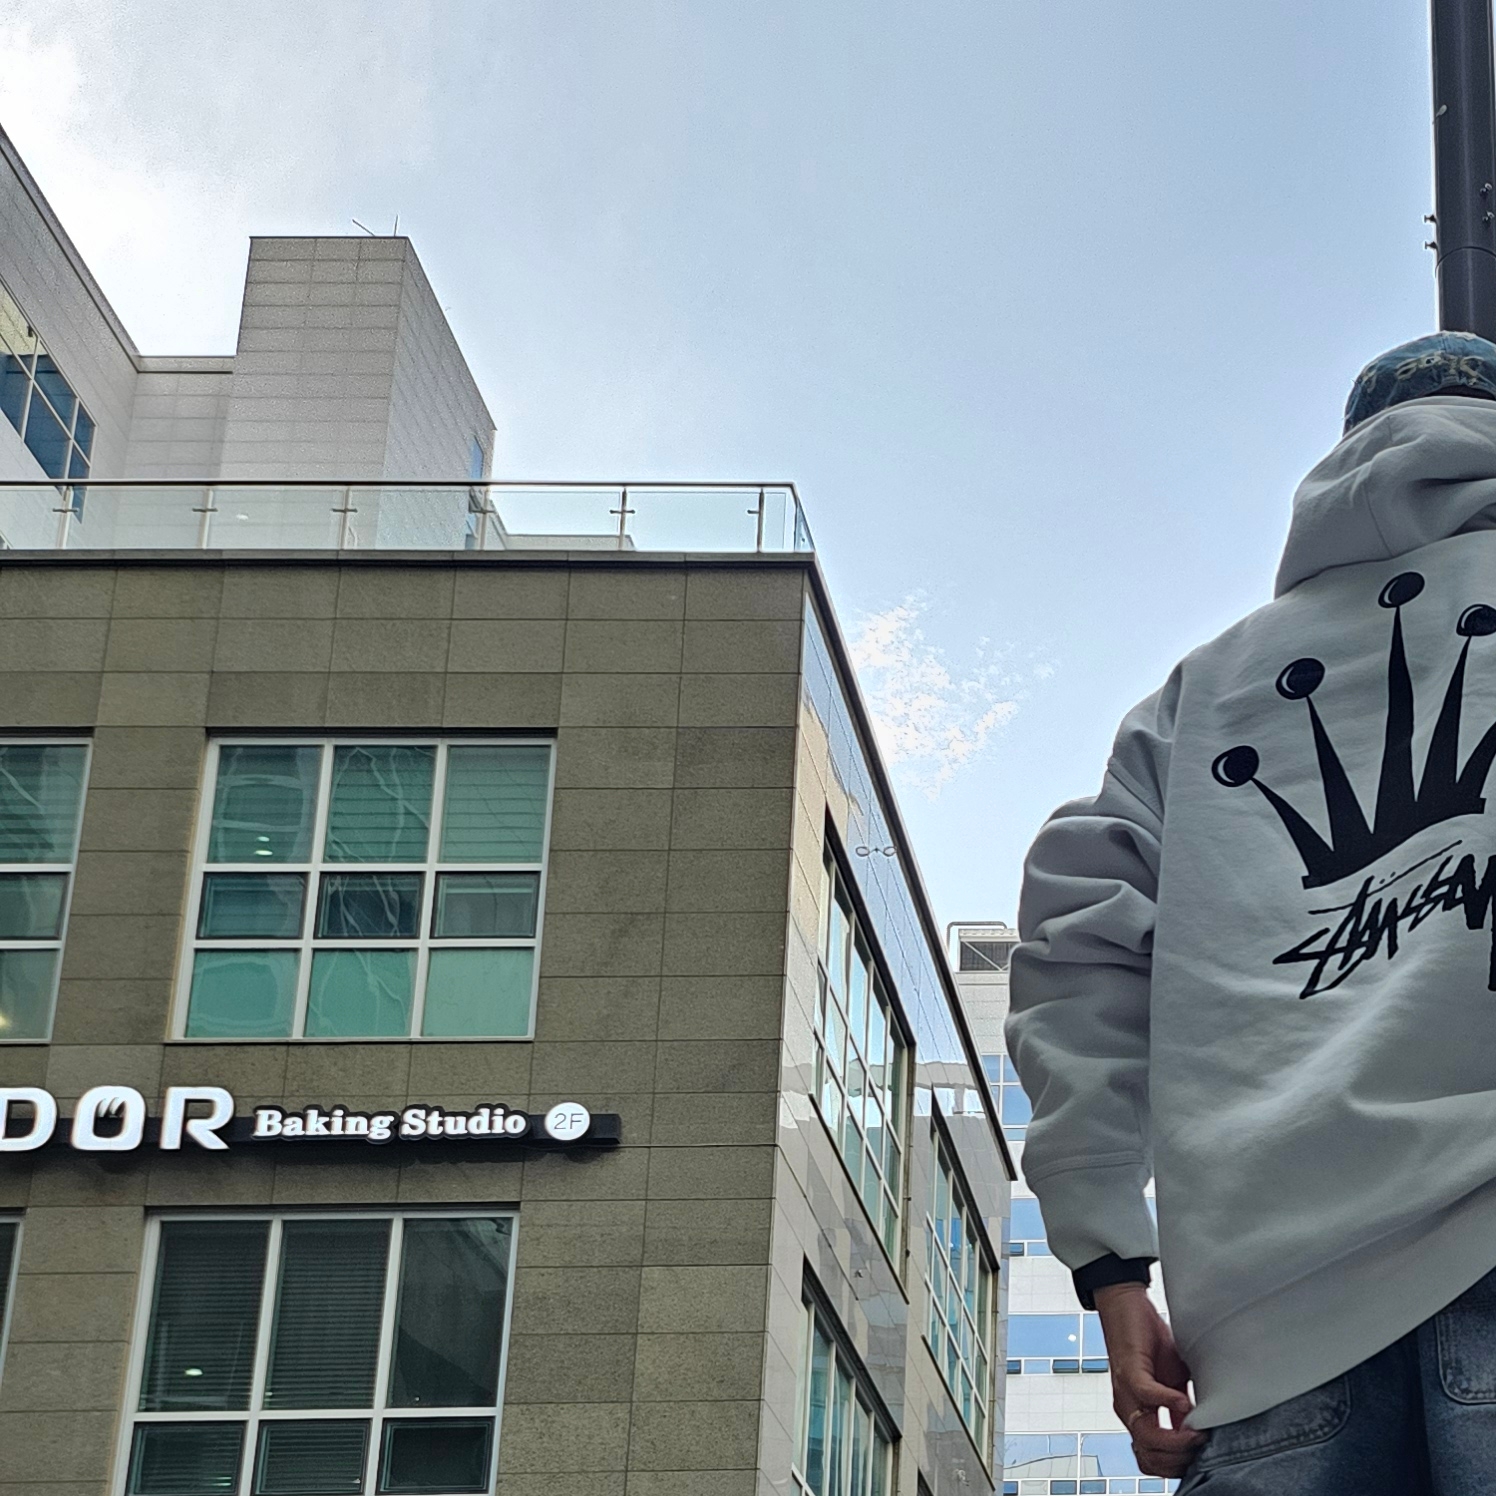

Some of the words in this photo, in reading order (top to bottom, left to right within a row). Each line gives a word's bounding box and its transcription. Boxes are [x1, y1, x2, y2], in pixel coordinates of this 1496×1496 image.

[252, 1108, 395, 1140] Baking
[401, 1107, 527, 1136] Studio
[554, 1112, 585, 1130] 2F
